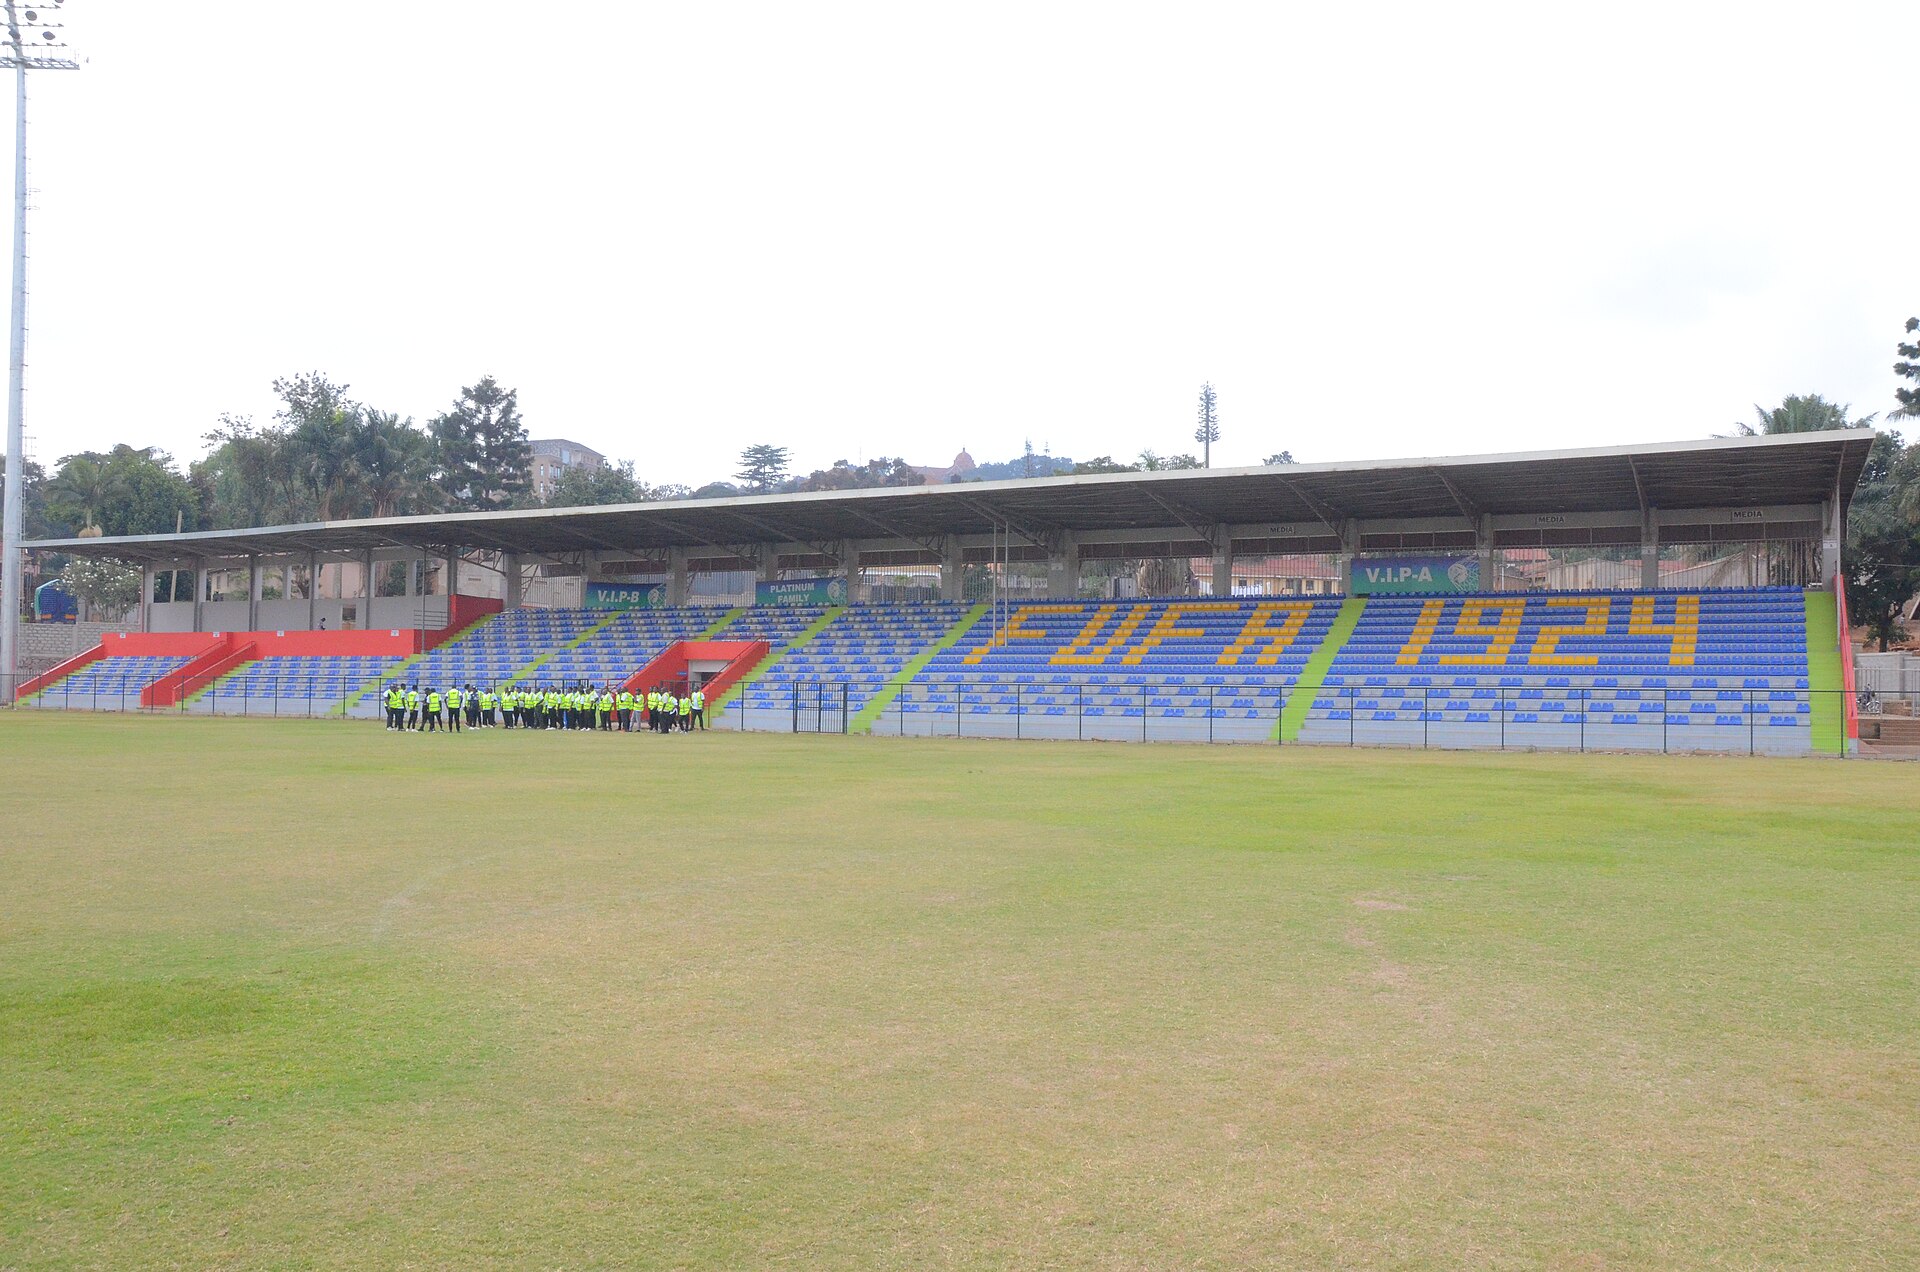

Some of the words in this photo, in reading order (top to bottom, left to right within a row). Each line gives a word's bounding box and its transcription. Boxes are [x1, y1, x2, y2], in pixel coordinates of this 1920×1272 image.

[1365, 566, 1433, 583] V.I.P-A
[770, 582, 815, 593] PLATINUM
[597, 590, 640, 603] V.I.P-B
[777, 594, 810, 604] FAMILY
[961, 602, 1314, 665] FUFA
[1395, 597, 1699, 665] 1924
